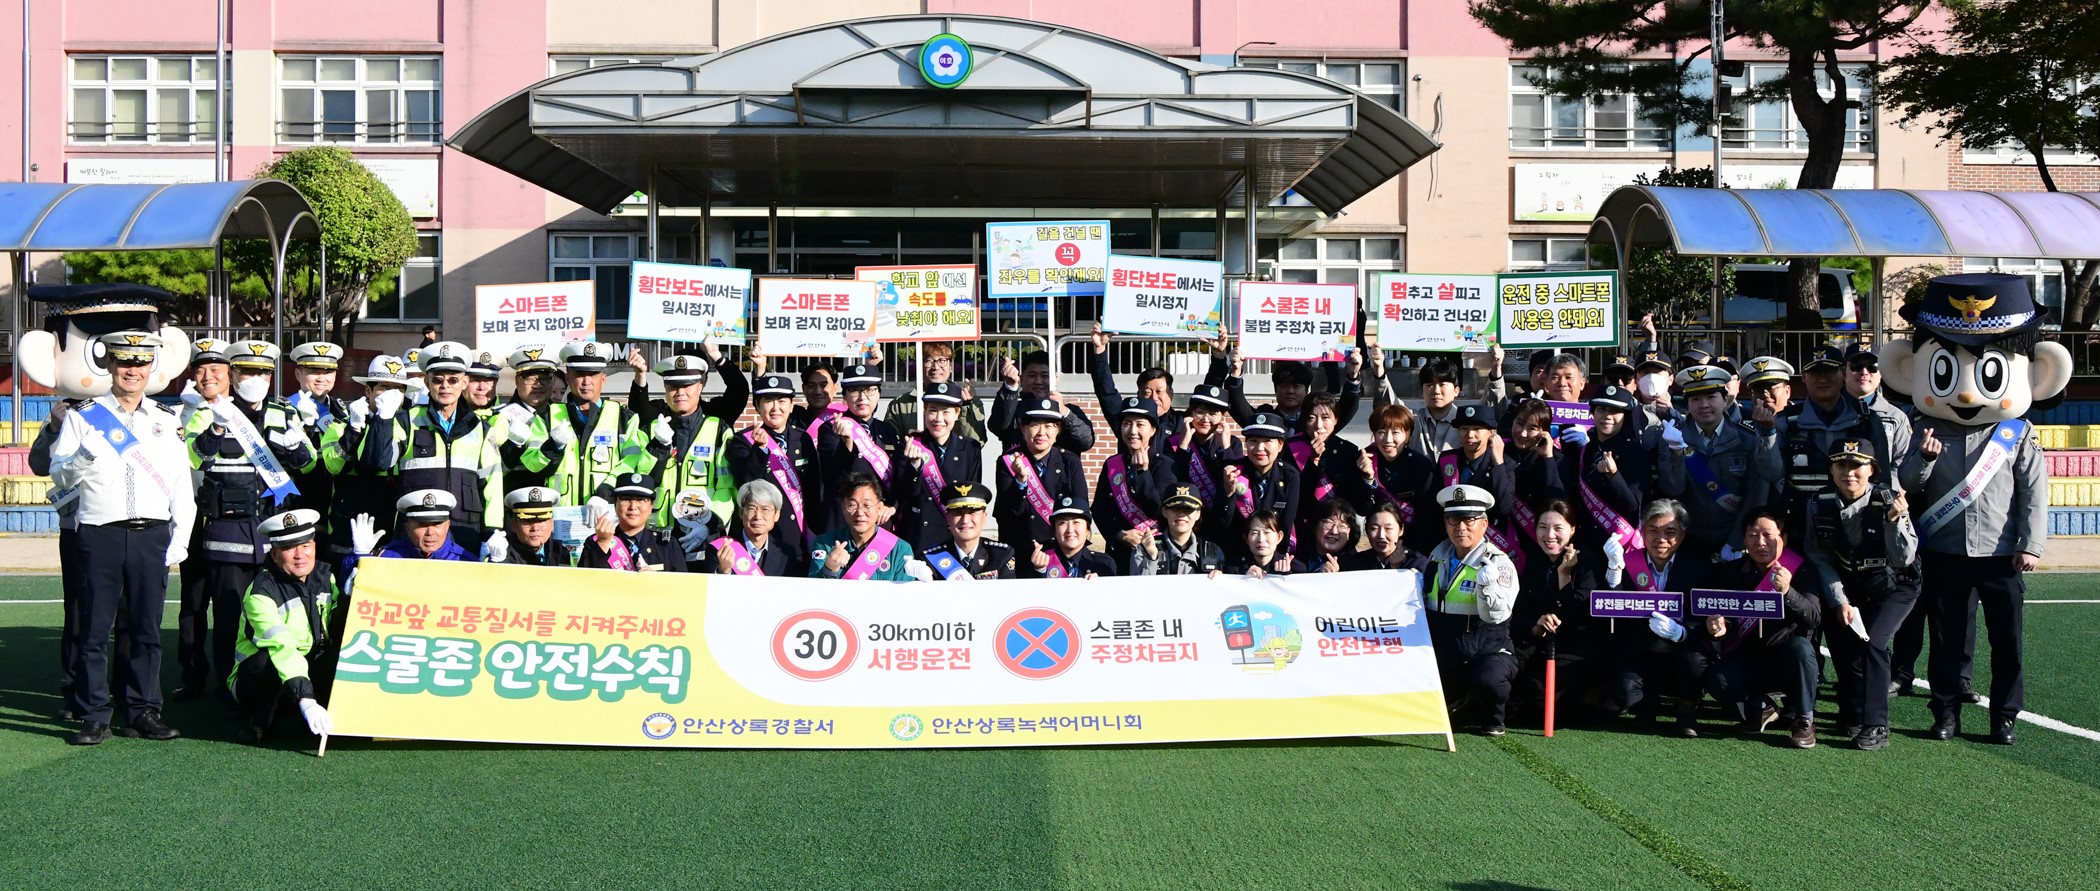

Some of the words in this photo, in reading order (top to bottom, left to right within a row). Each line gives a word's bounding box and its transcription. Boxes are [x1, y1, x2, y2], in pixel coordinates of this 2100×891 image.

[940, 57, 953, 65] 이호
[1036, 226, 1060, 241] 길을
[1063, 226, 1087, 241] 건널
[1089, 226, 1102, 241] 땐
[1061, 246, 1075, 262] 꼭
[890, 271, 920, 289] 학교
[999, 268, 1041, 285] 좌우를
[1044, 267, 1105, 284] 확인해요!
[1112, 268, 1215, 293] 횡단보도에서는
[638, 275, 743, 300] 횡단보도에서는
[1391, 282, 1433, 300] 멈추고
[1438, 282, 1480, 301] 살피고
[1502, 283, 1531, 305] 운전
[1535, 283, 1550, 305] 중
[1553, 281, 1610, 303] 스마트폰
[498, 295, 568, 315] 스마트폰
[661, 300, 715, 317] 일시정지
[781, 293, 850, 312] 스마트폰
[908, 291, 947, 307] 속도를
[1135, 293, 1189, 311] 일시정지
[1260, 296, 1310, 315] 스쿨존
[1315, 297, 1331, 315] 내
[895, 310, 939, 327] 낮춰야
[941, 310, 975, 326] 해요!
[1384, 303, 1440, 321] 확인하고
[1444, 308, 1487, 323] 건너요!
[1510, 308, 1554, 331] 사용은
[1558, 307, 1605, 329] 안돼요!
[482, 319, 509, 334] 보며
[513, 318, 540, 333] 걷지
[544, 316, 584, 332] 않아요
[764, 316, 791, 330] 보며
[795, 316, 821, 331] 걷지
[825, 317, 866, 332] 않아요
[1245, 319, 1271, 334] 불법
[1275, 320, 1315, 335] 주정차
[1319, 321, 1346, 335] 금지
[240, 427, 264, 456] 우리함께
[258, 454, 283, 485] 만들어요
[1933, 496, 1960, 520] 우리함께
[1594, 598, 1656, 611] #전동킥보드
[1657, 599, 1679, 612] 안전
[1697, 597, 1740, 611] #안전한
[1742, 599, 1777, 612] 스쿨존
[356, 599, 431, 631] 학교앞
[436, 604, 558, 636] 교통질서를
[565, 613, 687, 639] 지켜주세요
[1314, 614, 1400, 636] 어린이는
[867, 620, 976, 643] 30km이하
[1090, 619, 1156, 641] 스쿨존
[1163, 618, 1184, 641] 내
[794, 629, 837, 661] 30
[1090, 641, 1199, 665] 주정차금지
[1316, 635, 1405, 660] 안전보행
[336, 630, 477, 690] 스쿨존
[488, 640, 687, 698] 안전수칙
[867, 646, 972, 672] 서행운전
[683, 717, 834, 736] 안산상록경찰서
[932, 713, 1143, 736] 안산상록녹색어머니회
